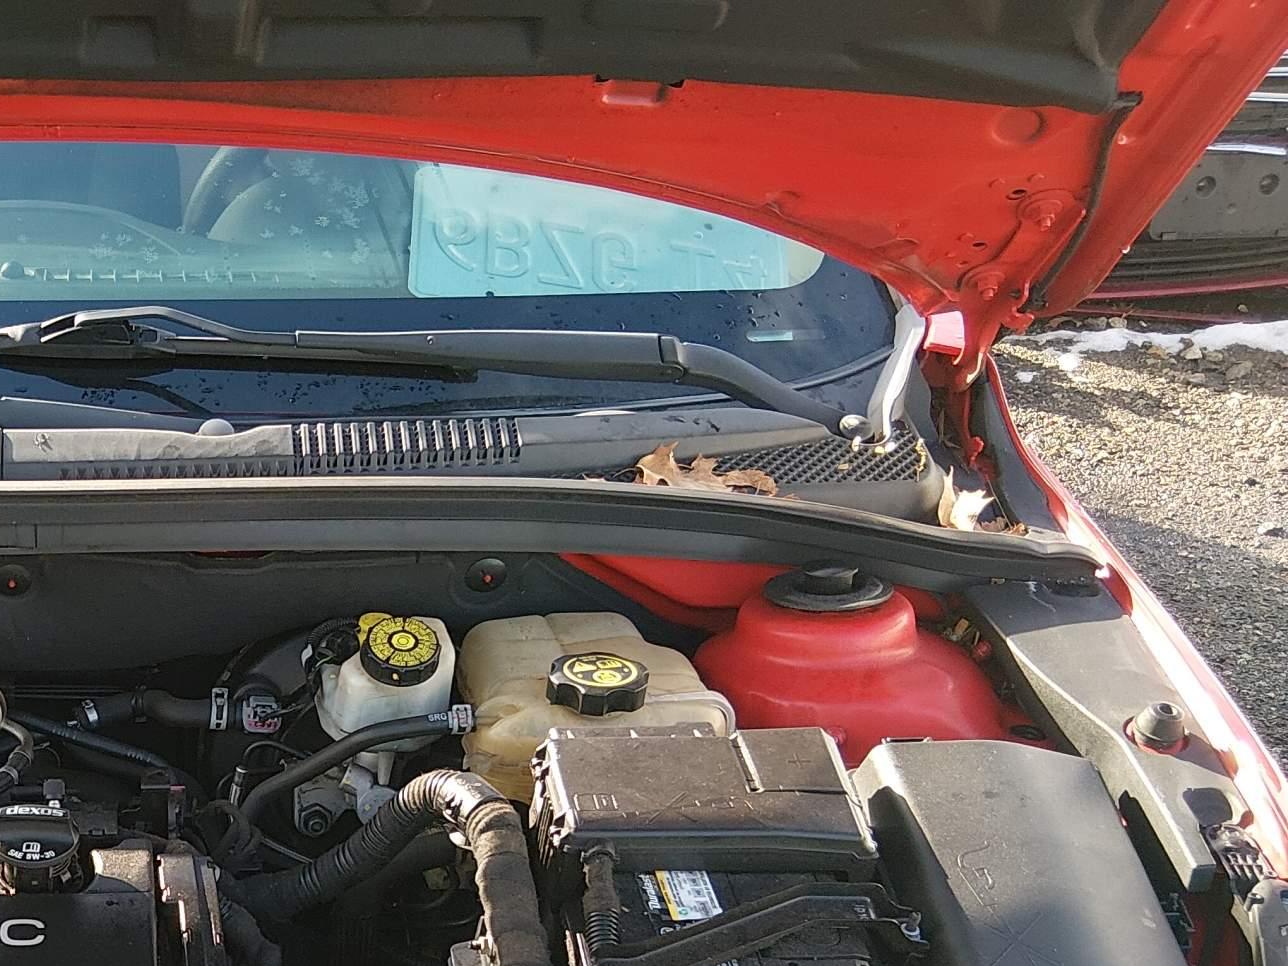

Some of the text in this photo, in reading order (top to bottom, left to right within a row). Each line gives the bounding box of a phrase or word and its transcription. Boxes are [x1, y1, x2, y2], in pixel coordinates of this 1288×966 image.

[5, 805, 66, 817] dexos
[7, 848, 56, 860] SAE 5W-30
